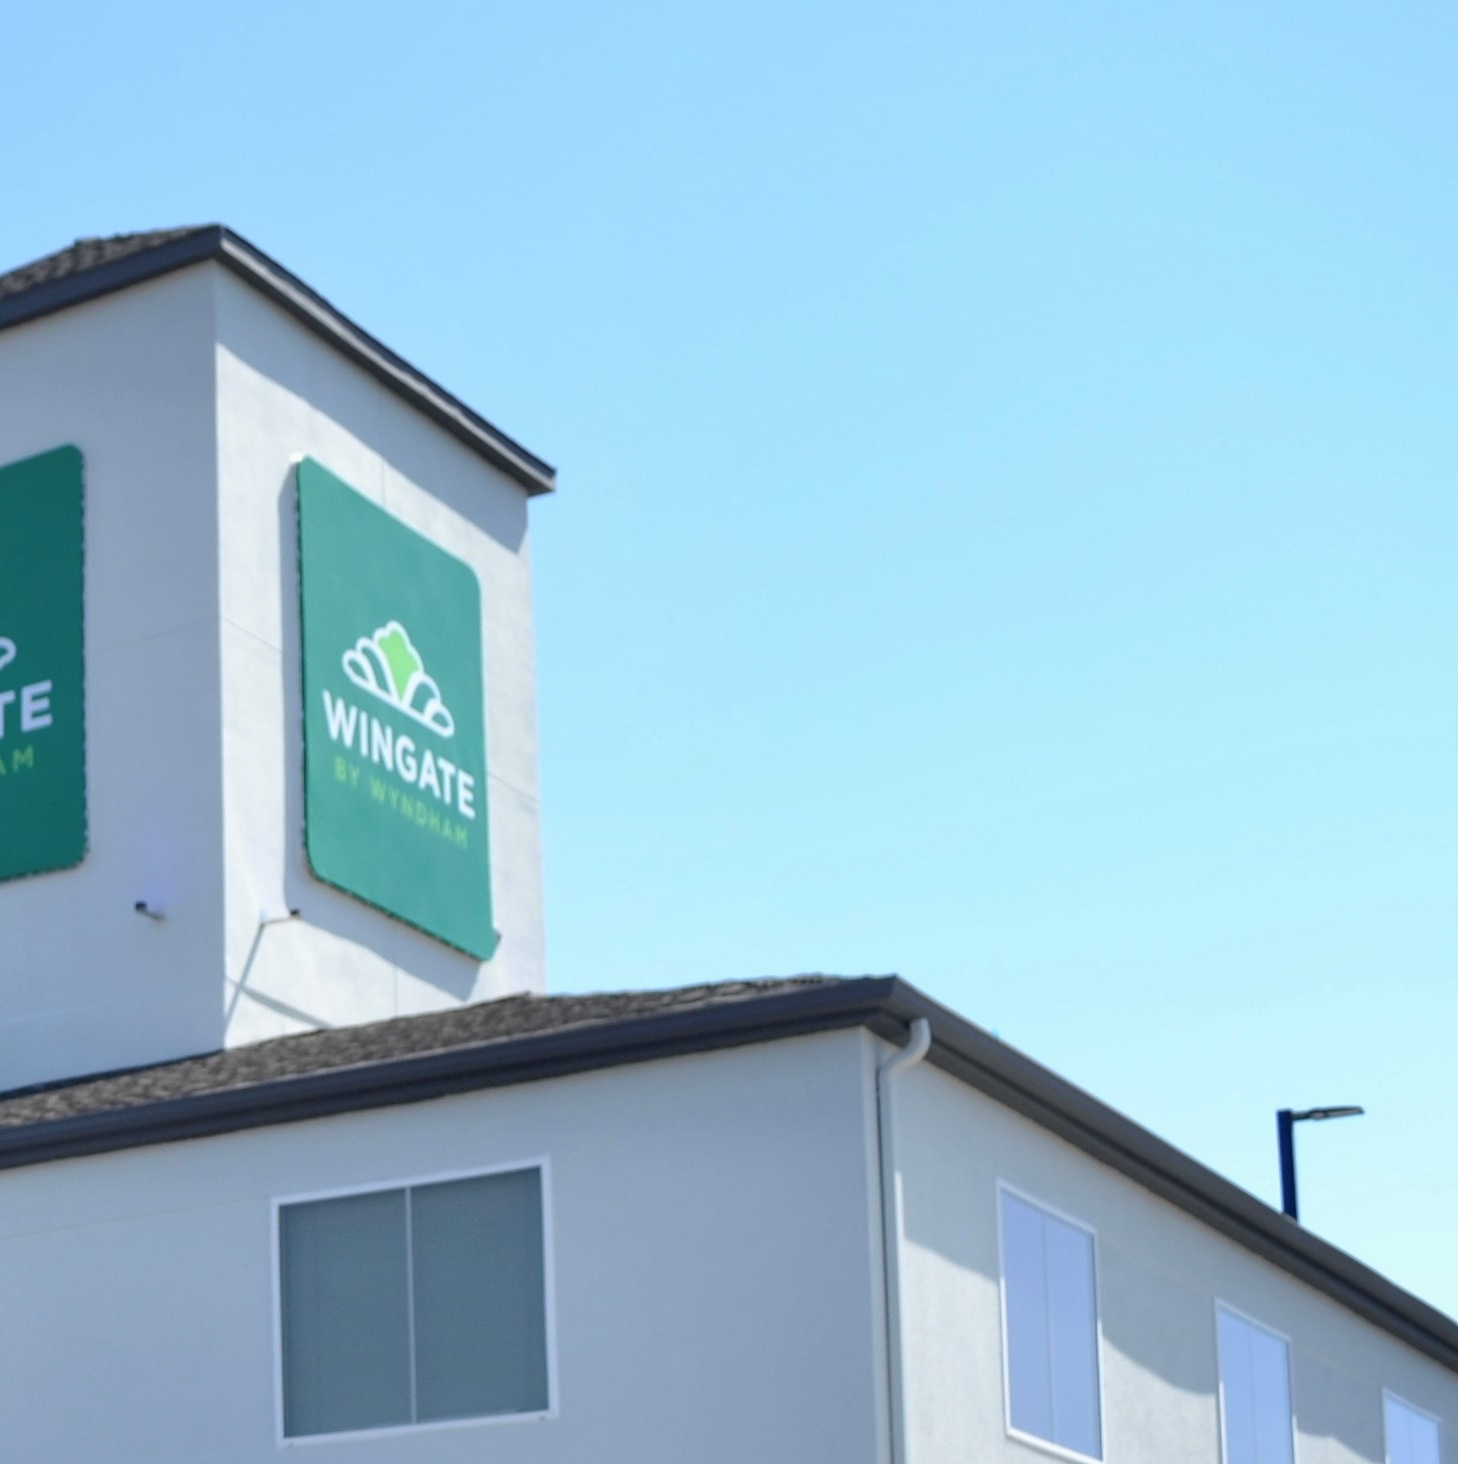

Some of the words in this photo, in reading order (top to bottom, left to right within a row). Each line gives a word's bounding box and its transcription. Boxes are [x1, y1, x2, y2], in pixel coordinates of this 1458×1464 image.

[322, 689, 476, 820] WINGATE
[334, 757, 360, 788] BY
[370, 775, 469, 850] WYNDHAM
